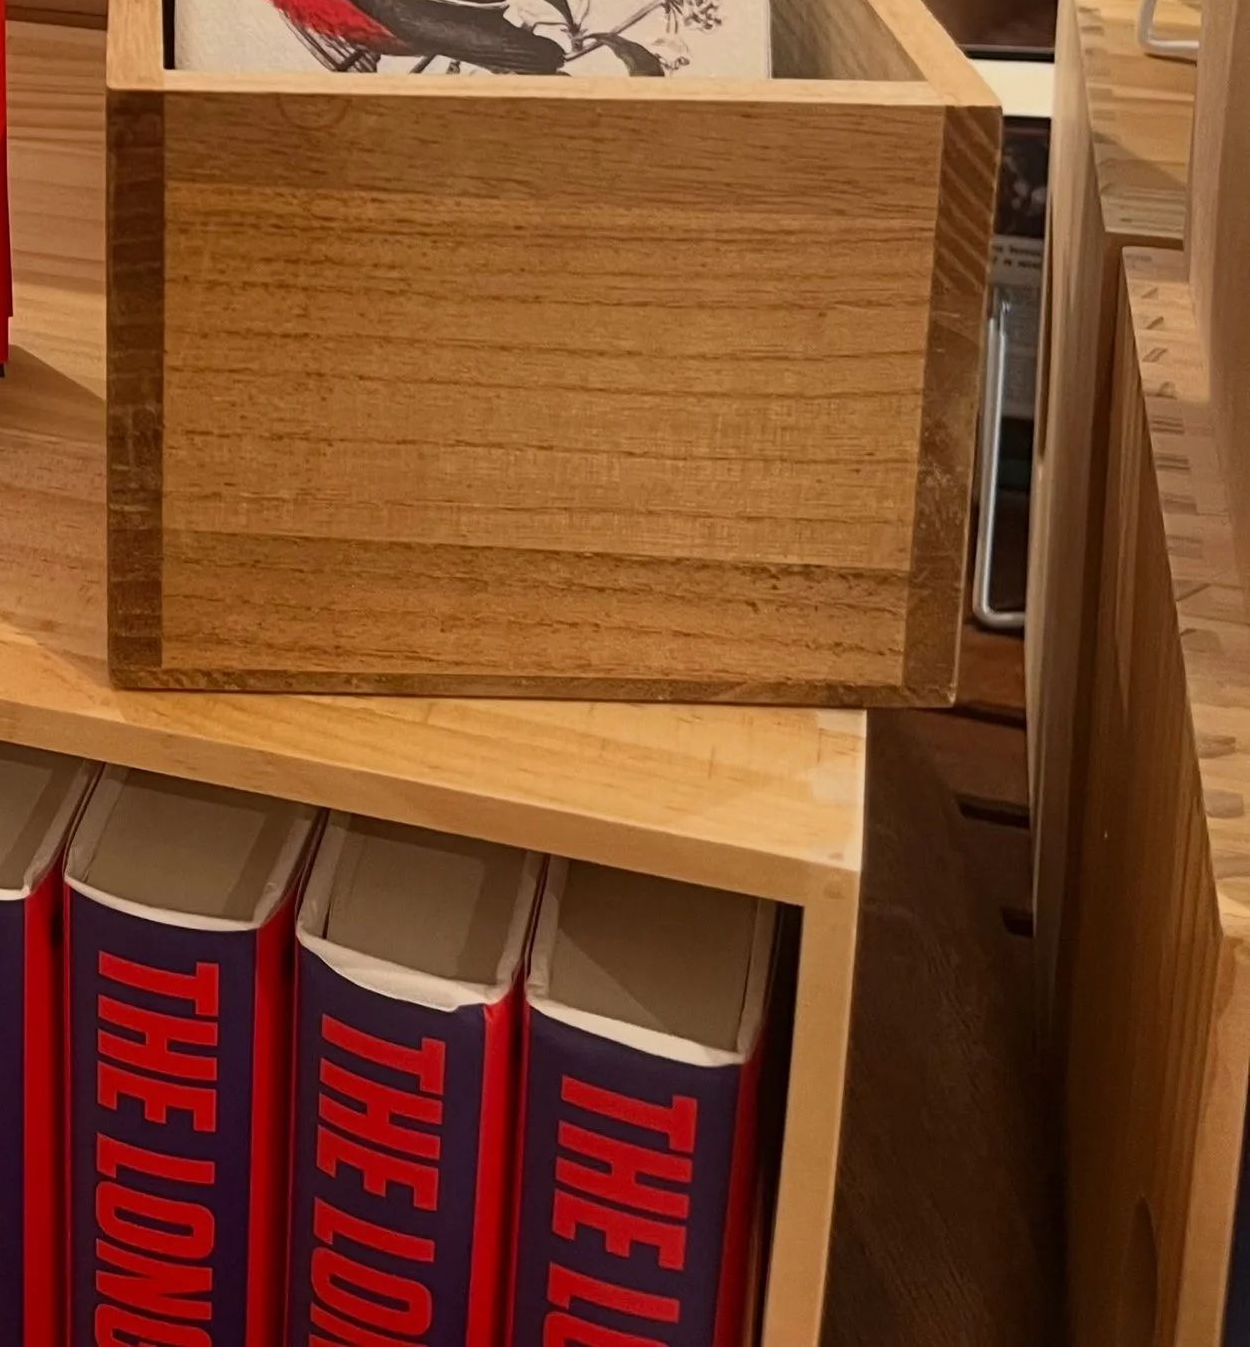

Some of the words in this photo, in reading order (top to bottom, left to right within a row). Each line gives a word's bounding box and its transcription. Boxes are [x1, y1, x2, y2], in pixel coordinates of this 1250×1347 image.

[96, 950, 220, 1134] THE
[316, 1014, 446, 1212] THE
[551, 1074, 698, 1272] THE
